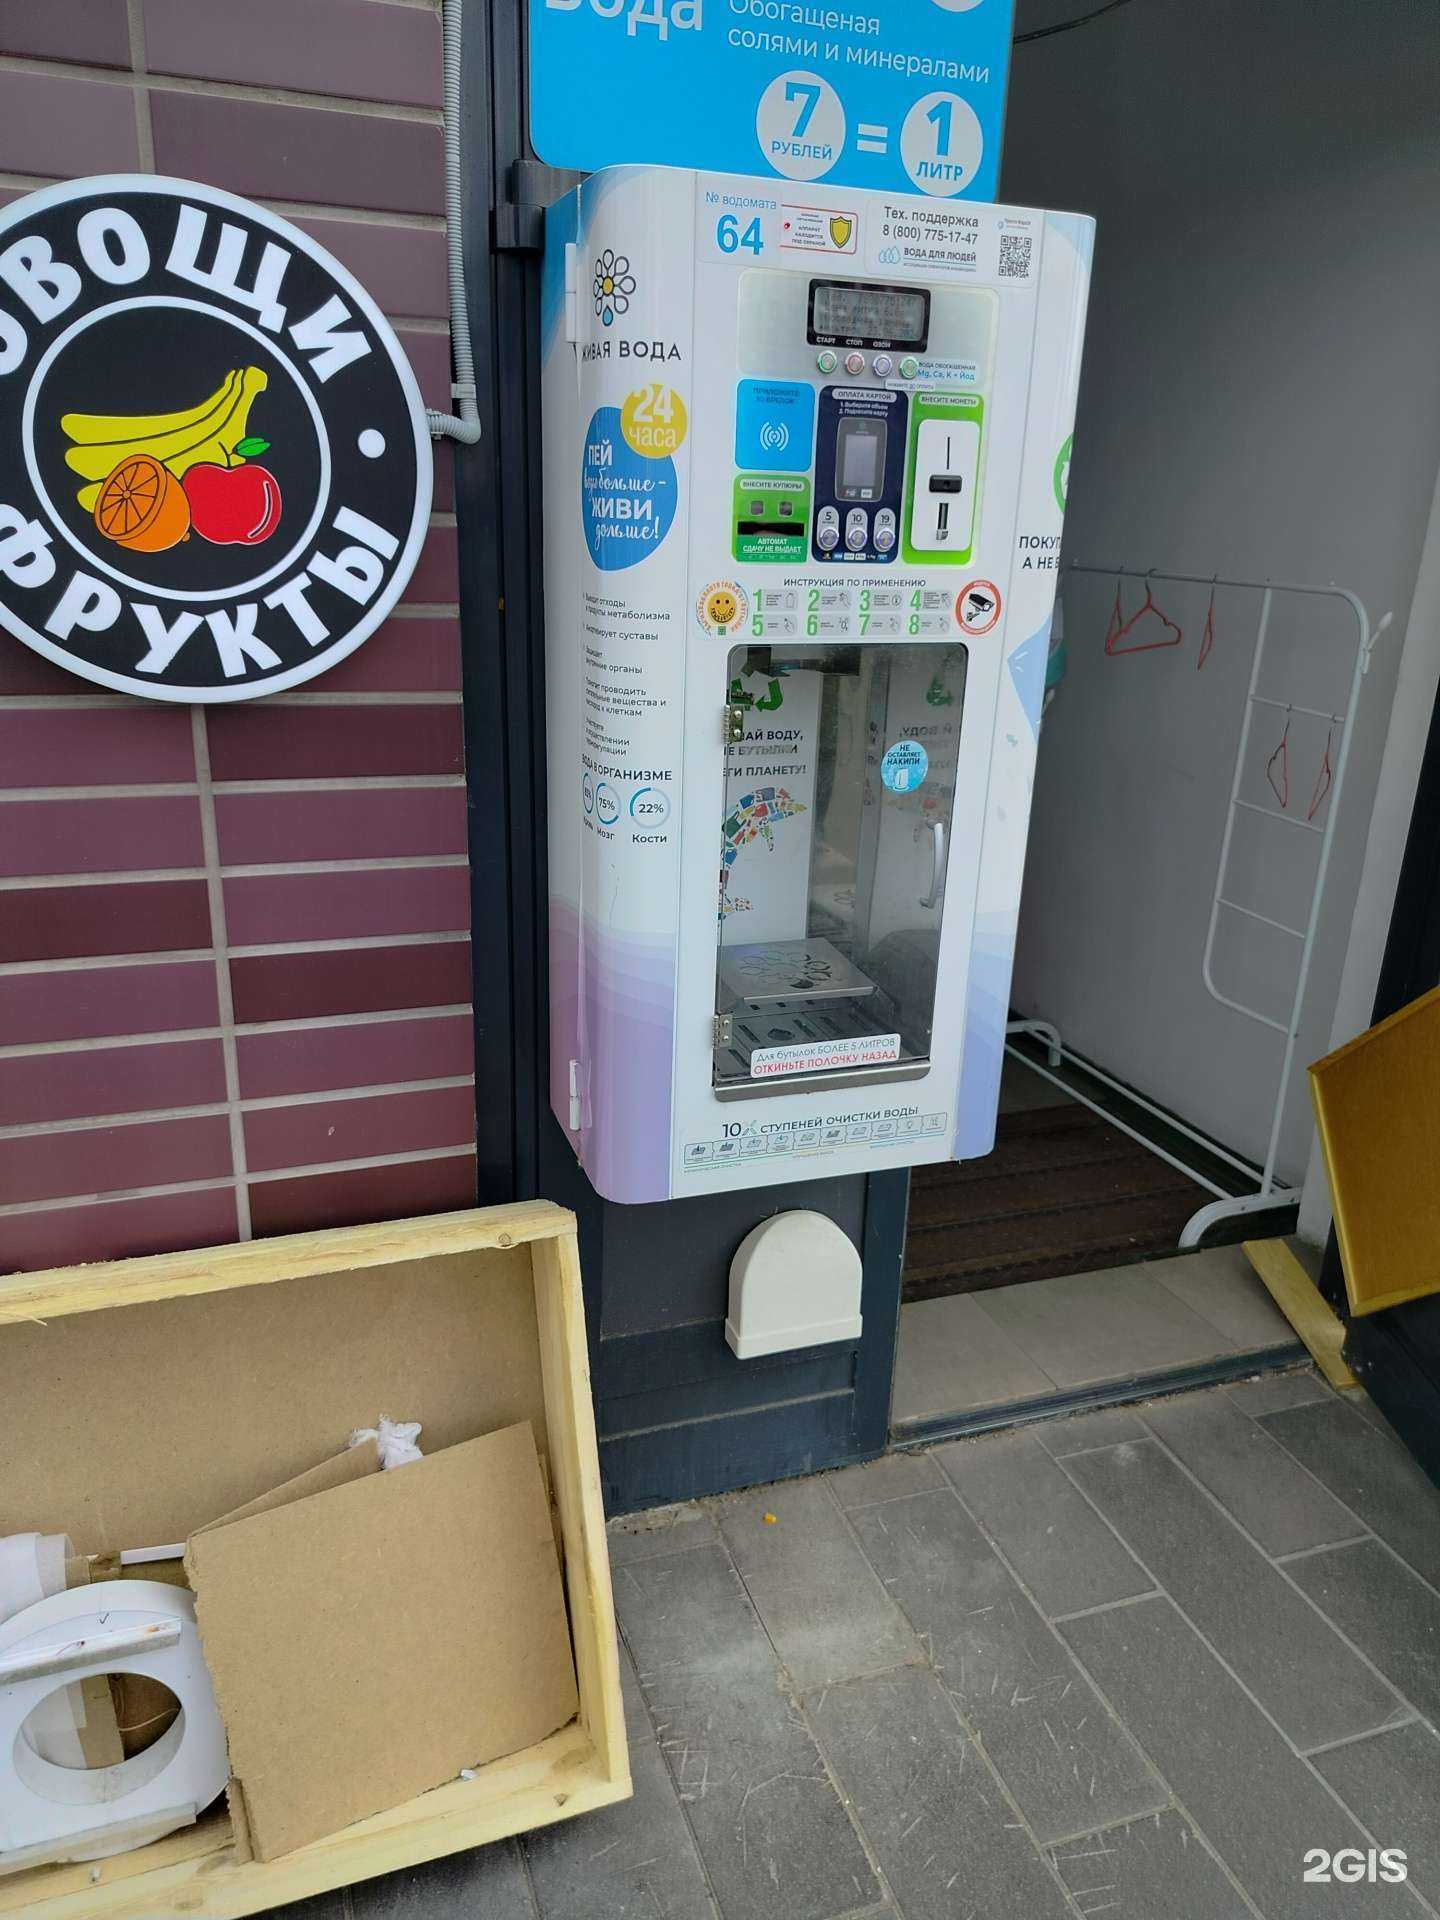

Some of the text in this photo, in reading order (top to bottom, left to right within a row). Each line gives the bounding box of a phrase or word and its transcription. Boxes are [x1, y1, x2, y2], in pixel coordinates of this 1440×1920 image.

[728, 28, 990, 84] солями и минералами
[785, 81, 821, 138] 7
[926, 100, 953, 157] 1
[771, 140, 833, 161] РУБЛЕЙ
[915, 160, 963, 181] ЛИТР
[705, 191, 777, 210] № водомата
[884, 206, 979, 228] Тех. поддержка
[716, 214, 764, 255] 64
[882, 224, 979, 245] 8 (800) 775-17-47
[904, 247, 976, 263] ВОДА ДЛЯ ЛЮДЕЙ
[619, 340, 681, 362] ВОДА
[816, 336, 836, 345] СТАРТ
[846, 338, 863, 347] СТОП
[632, 384, 674, 424] 24
[838, 390, 891, 400] ОПЛАТА КАРТОЙ
[921, 396, 976, 405] ВНЕСИТЕ МОНЕТЫ
[629, 427, 677, 448] часа
[588, 439, 612, 466] ПЕЙ
[598, 467, 655, 492] больше
[743, 481, 802, 490] ВНЕСИТЕ КУПЮРЫ
[591, 496, 653, 521] ЖИВИ
[825, 511, 832, 521] 5
[852, 513, 862, 524] 10
[881, 514, 890, 524] 19
[594, 516, 660, 551] дольше!
[757, 537, 787, 545] АВТОМАТ
[743, 545, 763, 553] СДАЧУ
[774, 546, 801, 554] ВЫДАЕТ
[1022, 557, 1032, 569] А
[1037, 557, 1053, 569] НЕ
[0, 504, 400, 678] ФРУКТЫ
[783, 578, 926, 588] ИНСТРУКЦИЯ ПО ПРИМЕНЕНИЮ
[752, 589, 762, 612] 1
[807, 589, 820, 612] 2
[859, 589, 871, 612] 3
[910, 590, 922, 612] 4
[752, 614, 764, 637] 5
[806, 614, 818, 636] 6
[859, 614, 871, 636] 7
[908, 614, 920, 636] 8
[619, 631, 658, 641] суставы
[609, 664, 642, 674] органы
[612, 696, 657, 707] вещества
[767, 729, 803, 741] ВОДУ,
[599, 764, 673, 781] ОРГАНИЗМЕ
[746, 764, 806, 777] ПЛАНЕТУ!
[887, 758, 920, 766] НАКИПИ
[599, 797, 616, 811] 75%
[639, 803, 664, 814] 22%
[632, 834, 667, 843] Кости
[756, 1037, 895, 1063] Для бутылок БОЛЕЕ 5 ЛИТРОВ
[754, 1050, 897, 1076] ОТКИНЬТЕ ПОЛОЧКУ НАЗАД
[760, 1117, 823, 1134] СТУПЕНЕЙ
[826, 1109, 881, 1126] ОЧИСТКИ
[884, 1106, 919, 1119] ВОДЫ
